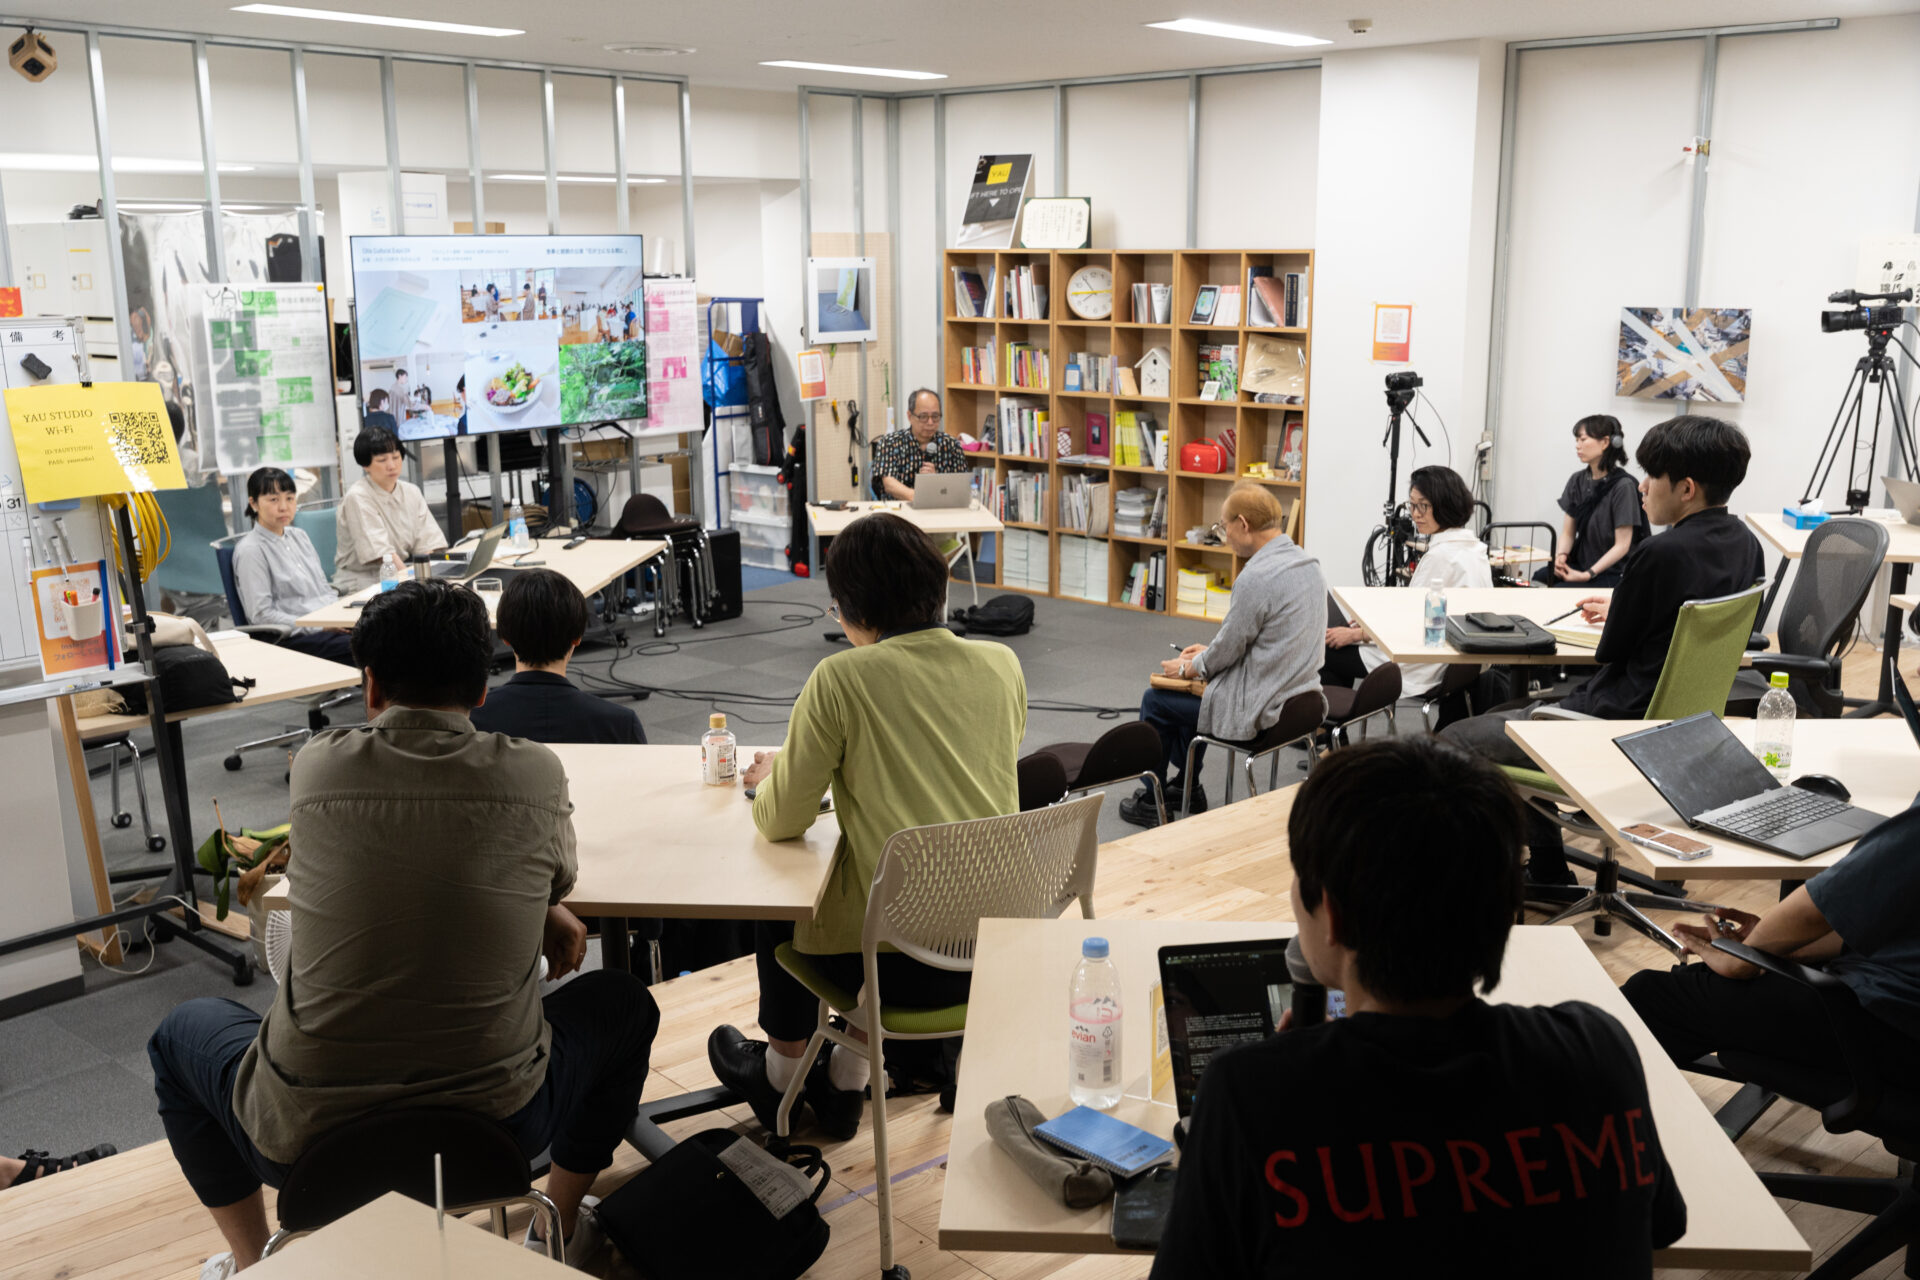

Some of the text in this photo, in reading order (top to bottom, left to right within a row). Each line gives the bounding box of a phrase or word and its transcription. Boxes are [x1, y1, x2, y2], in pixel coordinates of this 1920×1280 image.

[991, 169, 1009, 177] YAU
[980, 189, 998, 198] HERE
[1000, 187, 1009, 195] TO
[23, 409, 93, 423] YAU STUDIO
[45, 425, 74, 436] Wi-Fi
[6, 497, 21, 510] 31
[1071, 1029, 1097, 1044] evian
[1264, 1107, 1655, 1228] SUPREME
